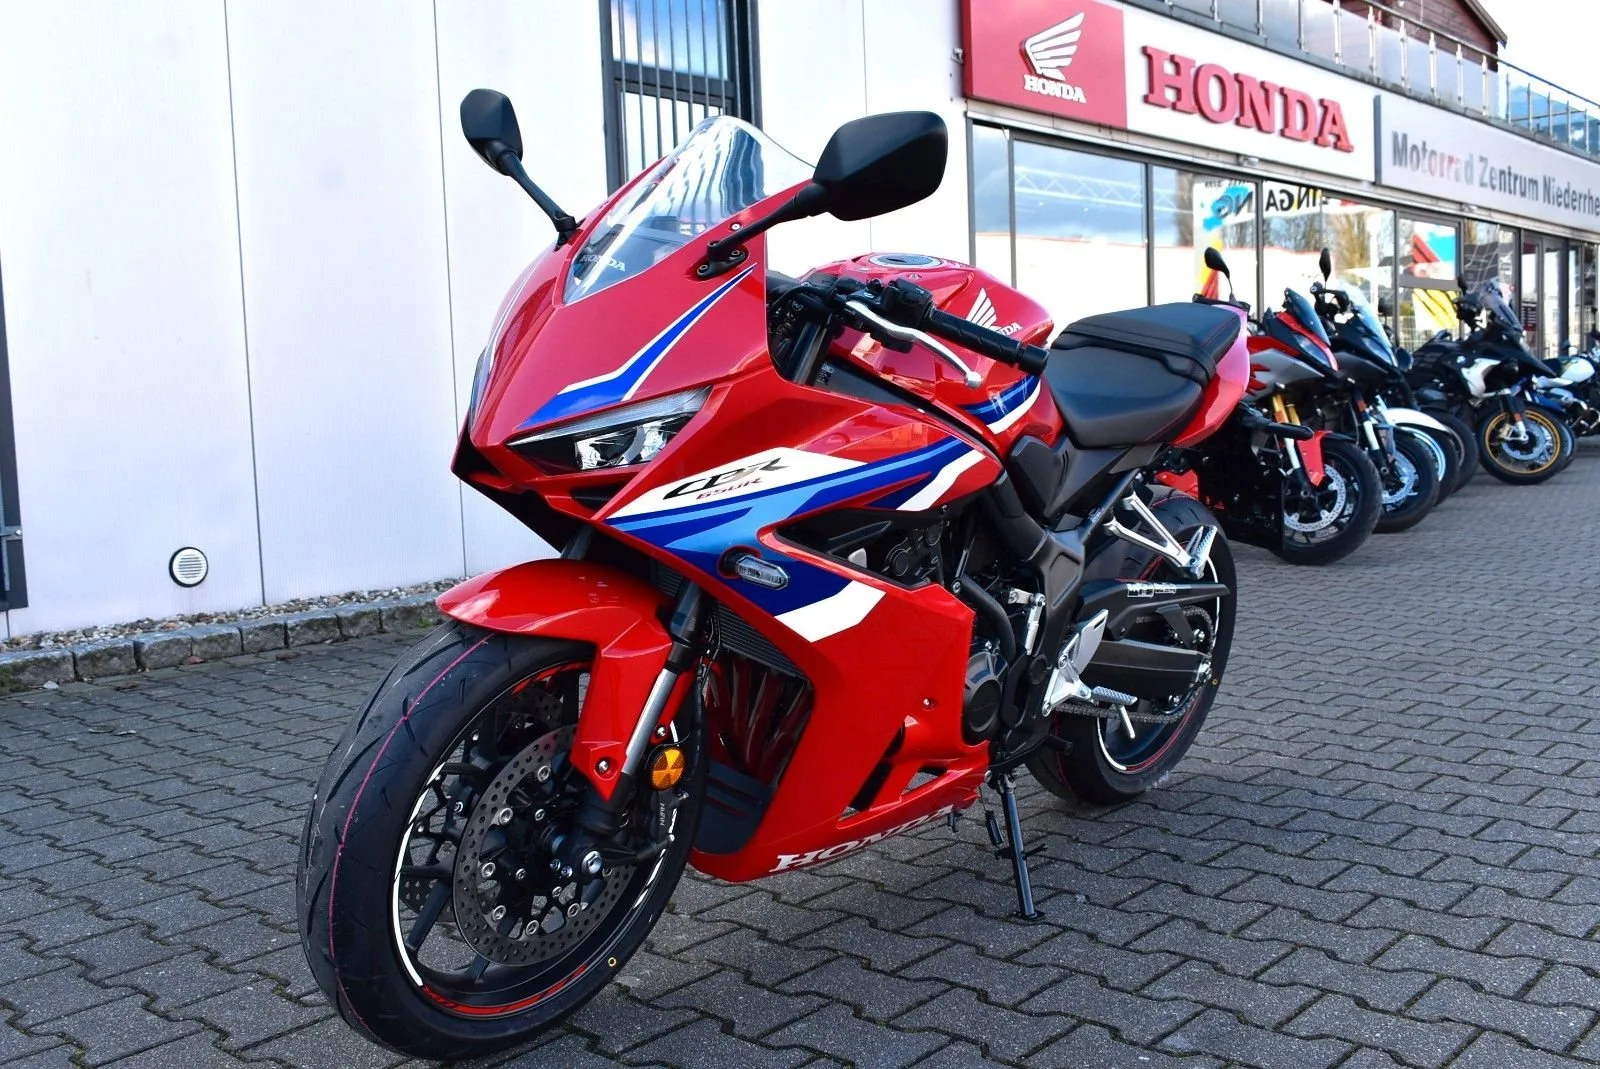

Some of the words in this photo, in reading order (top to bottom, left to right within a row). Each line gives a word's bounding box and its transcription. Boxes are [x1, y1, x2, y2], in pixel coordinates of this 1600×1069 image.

[1023, 74, 1086, 103] HONDA
[1141, 46, 1354, 152] HONDA
[1391, 131, 1474, 186] Motorrad
[1479, 155, 1538, 200] Zentrum
[663, 457, 789, 500] CBR
[769, 804, 954, 873] HONDA
